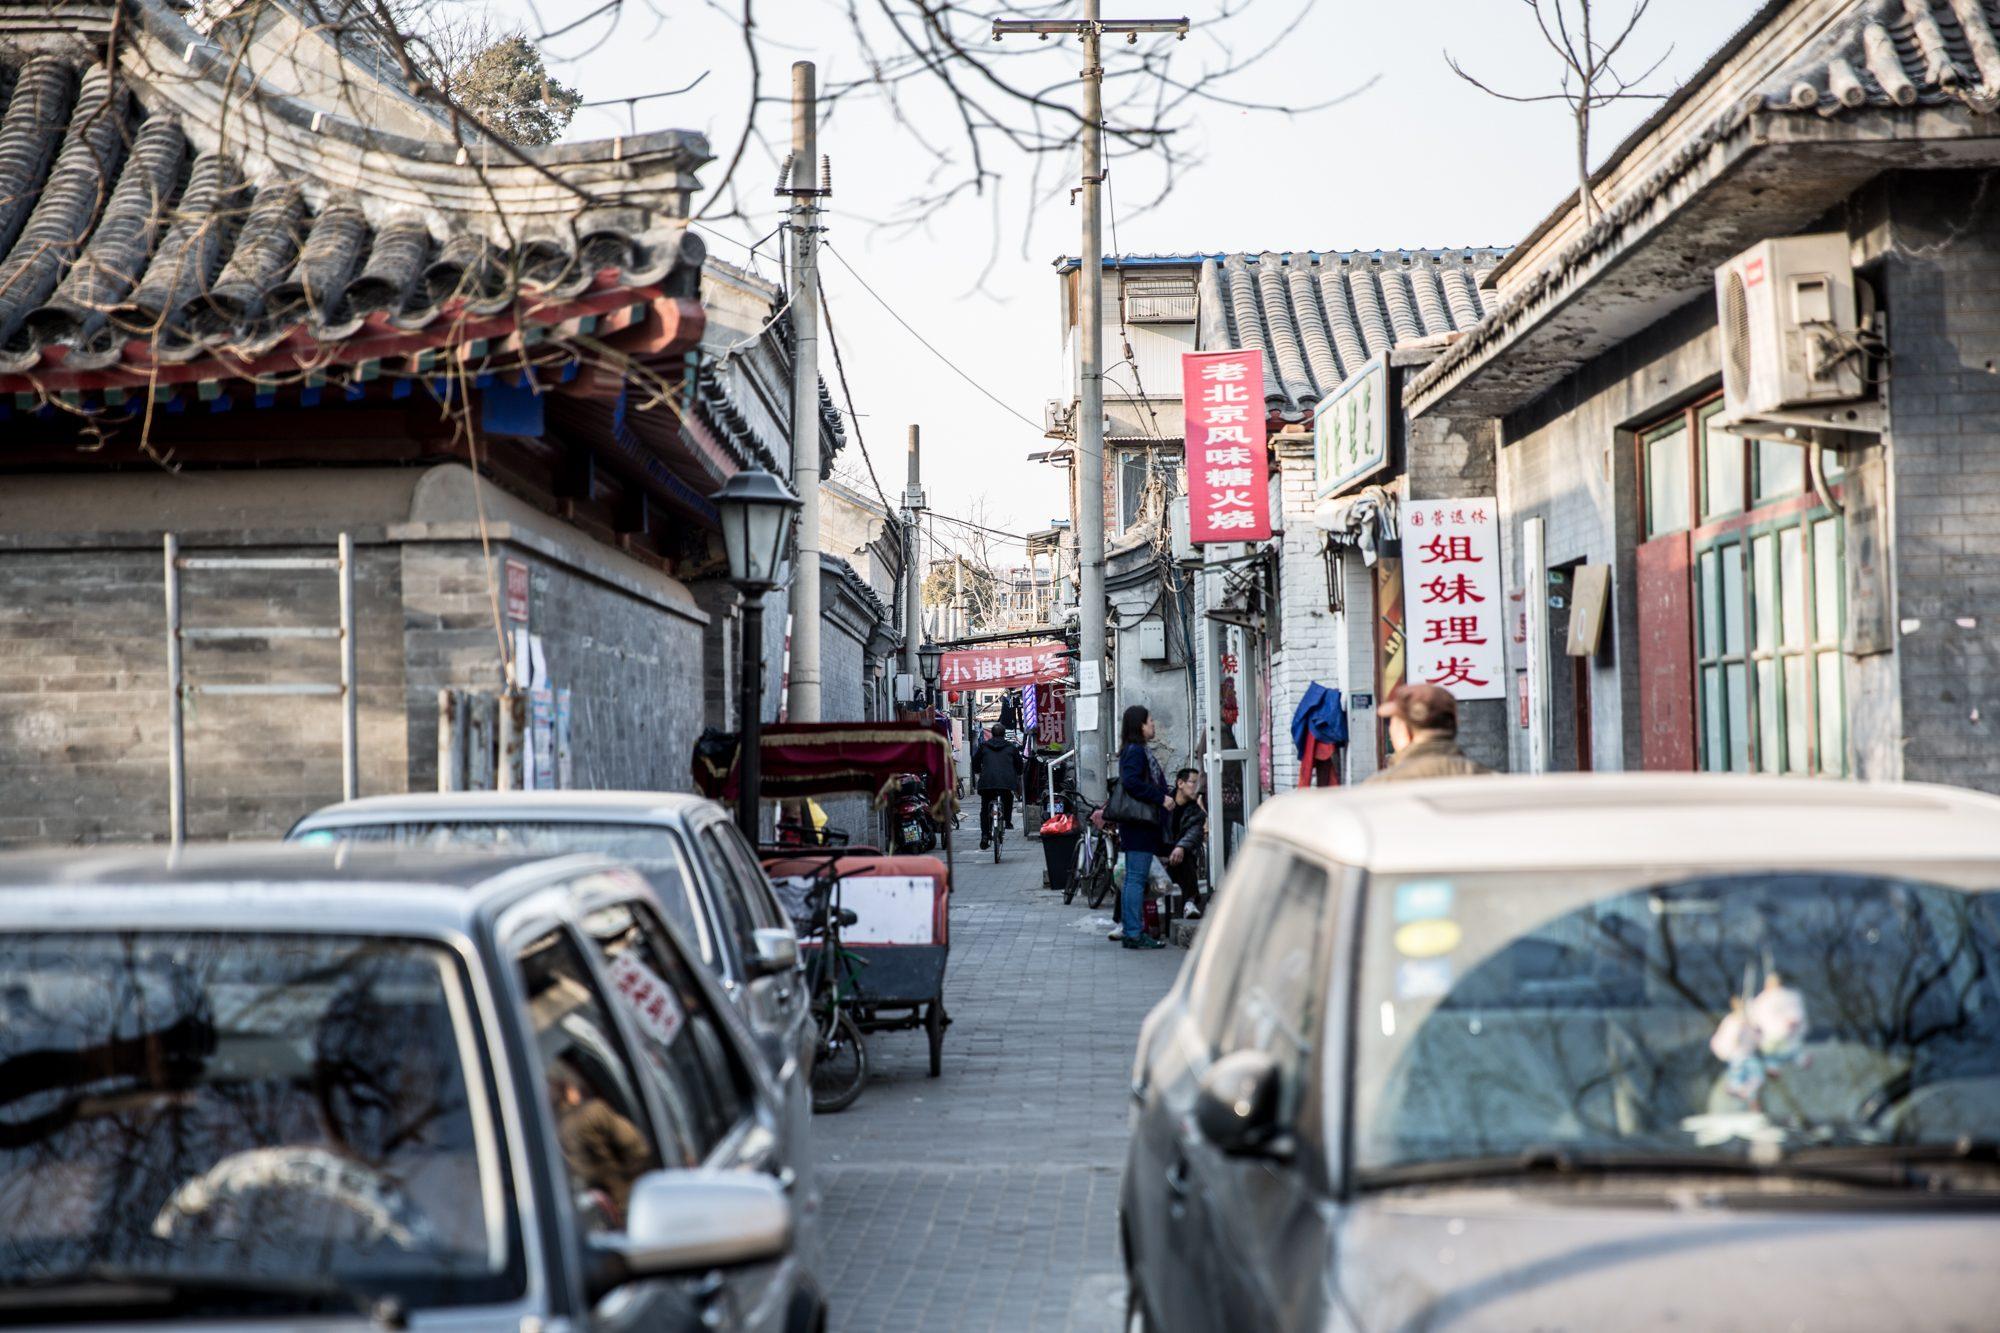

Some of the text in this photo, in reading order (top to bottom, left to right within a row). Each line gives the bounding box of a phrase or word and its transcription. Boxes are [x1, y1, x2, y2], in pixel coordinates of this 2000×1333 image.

[1201, 362, 1256, 529] 老北京风味糖火烧
[1419, 534, 1489, 686] 姐妹理发
[1038, 684, 1065, 743] 小谢
